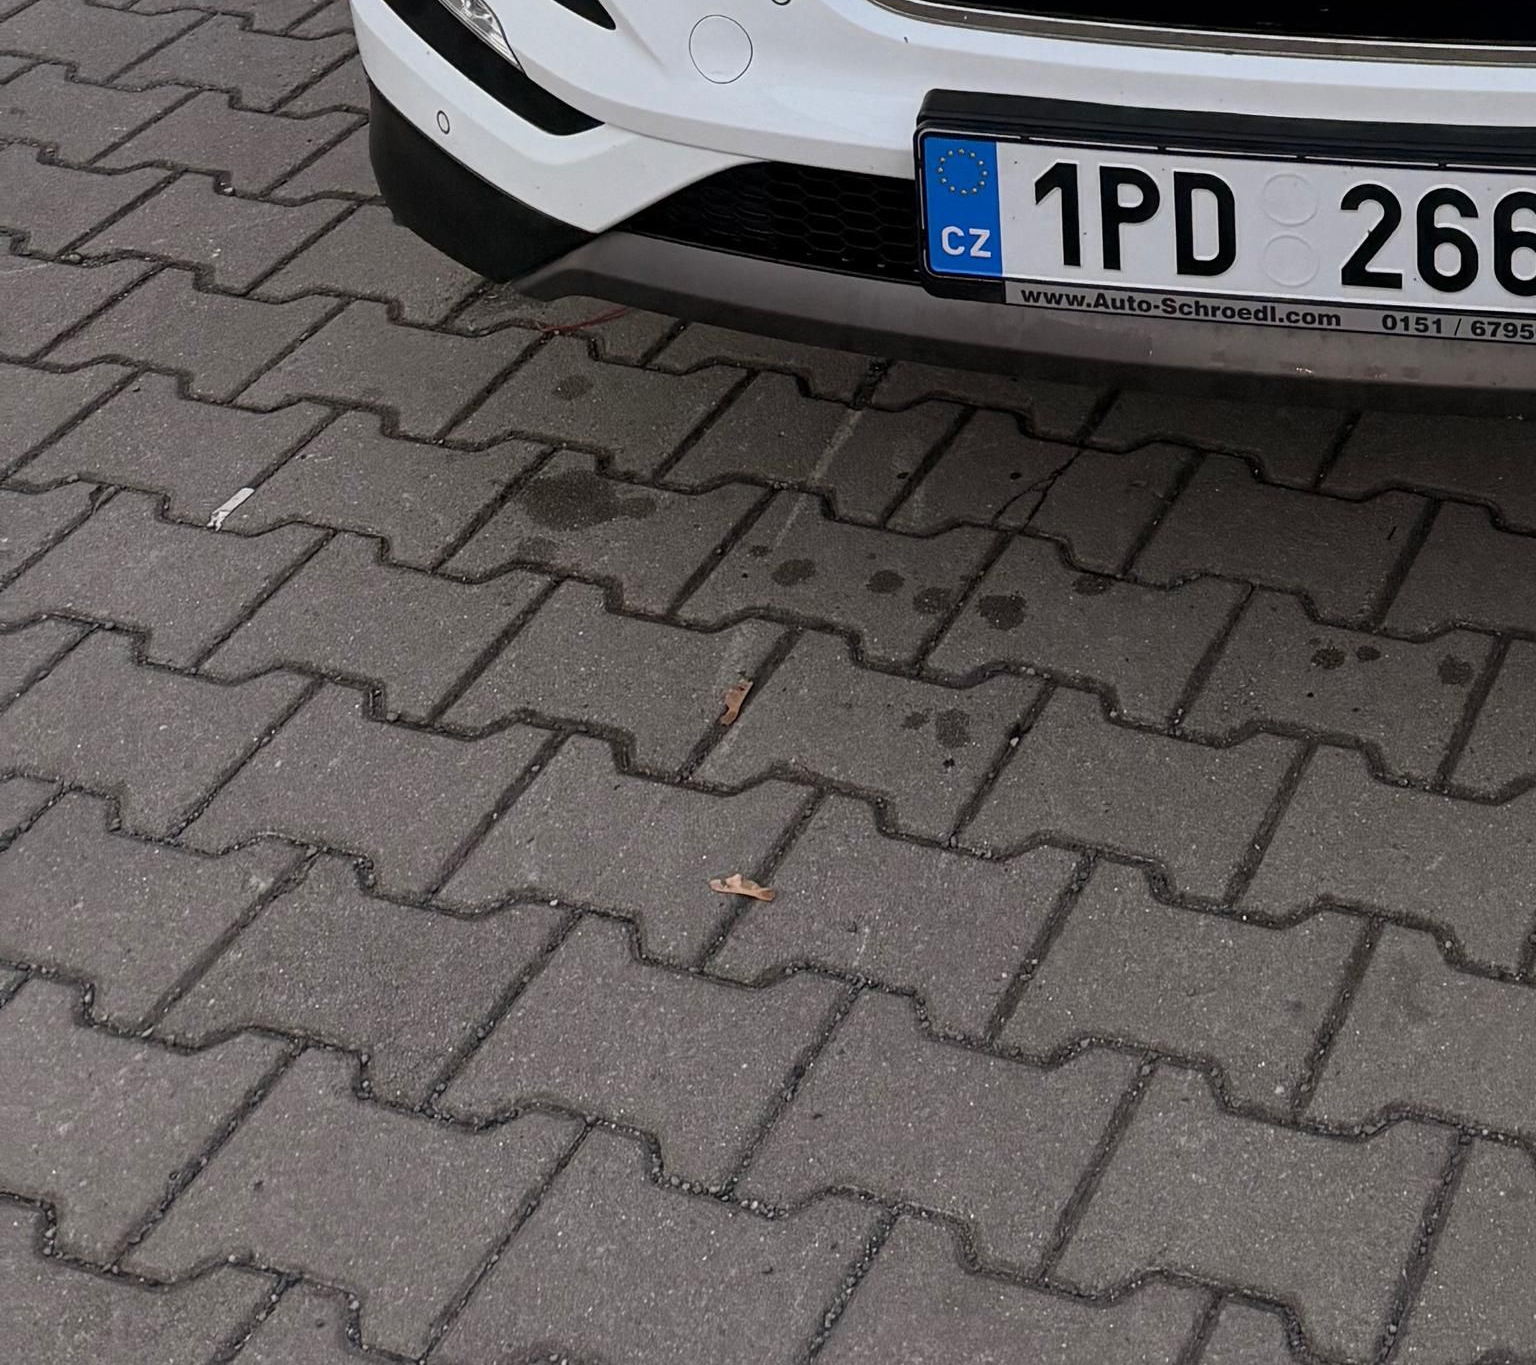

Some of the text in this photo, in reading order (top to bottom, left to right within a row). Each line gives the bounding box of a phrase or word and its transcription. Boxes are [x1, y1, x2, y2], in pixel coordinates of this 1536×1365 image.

[940, 225, 992, 259] CZ
[1034, 162, 1237, 277] 1PD
[1020, 288, 1342, 328] www.Auto-Schroedl.com
[1381, 313, 1443, 335] 0151
